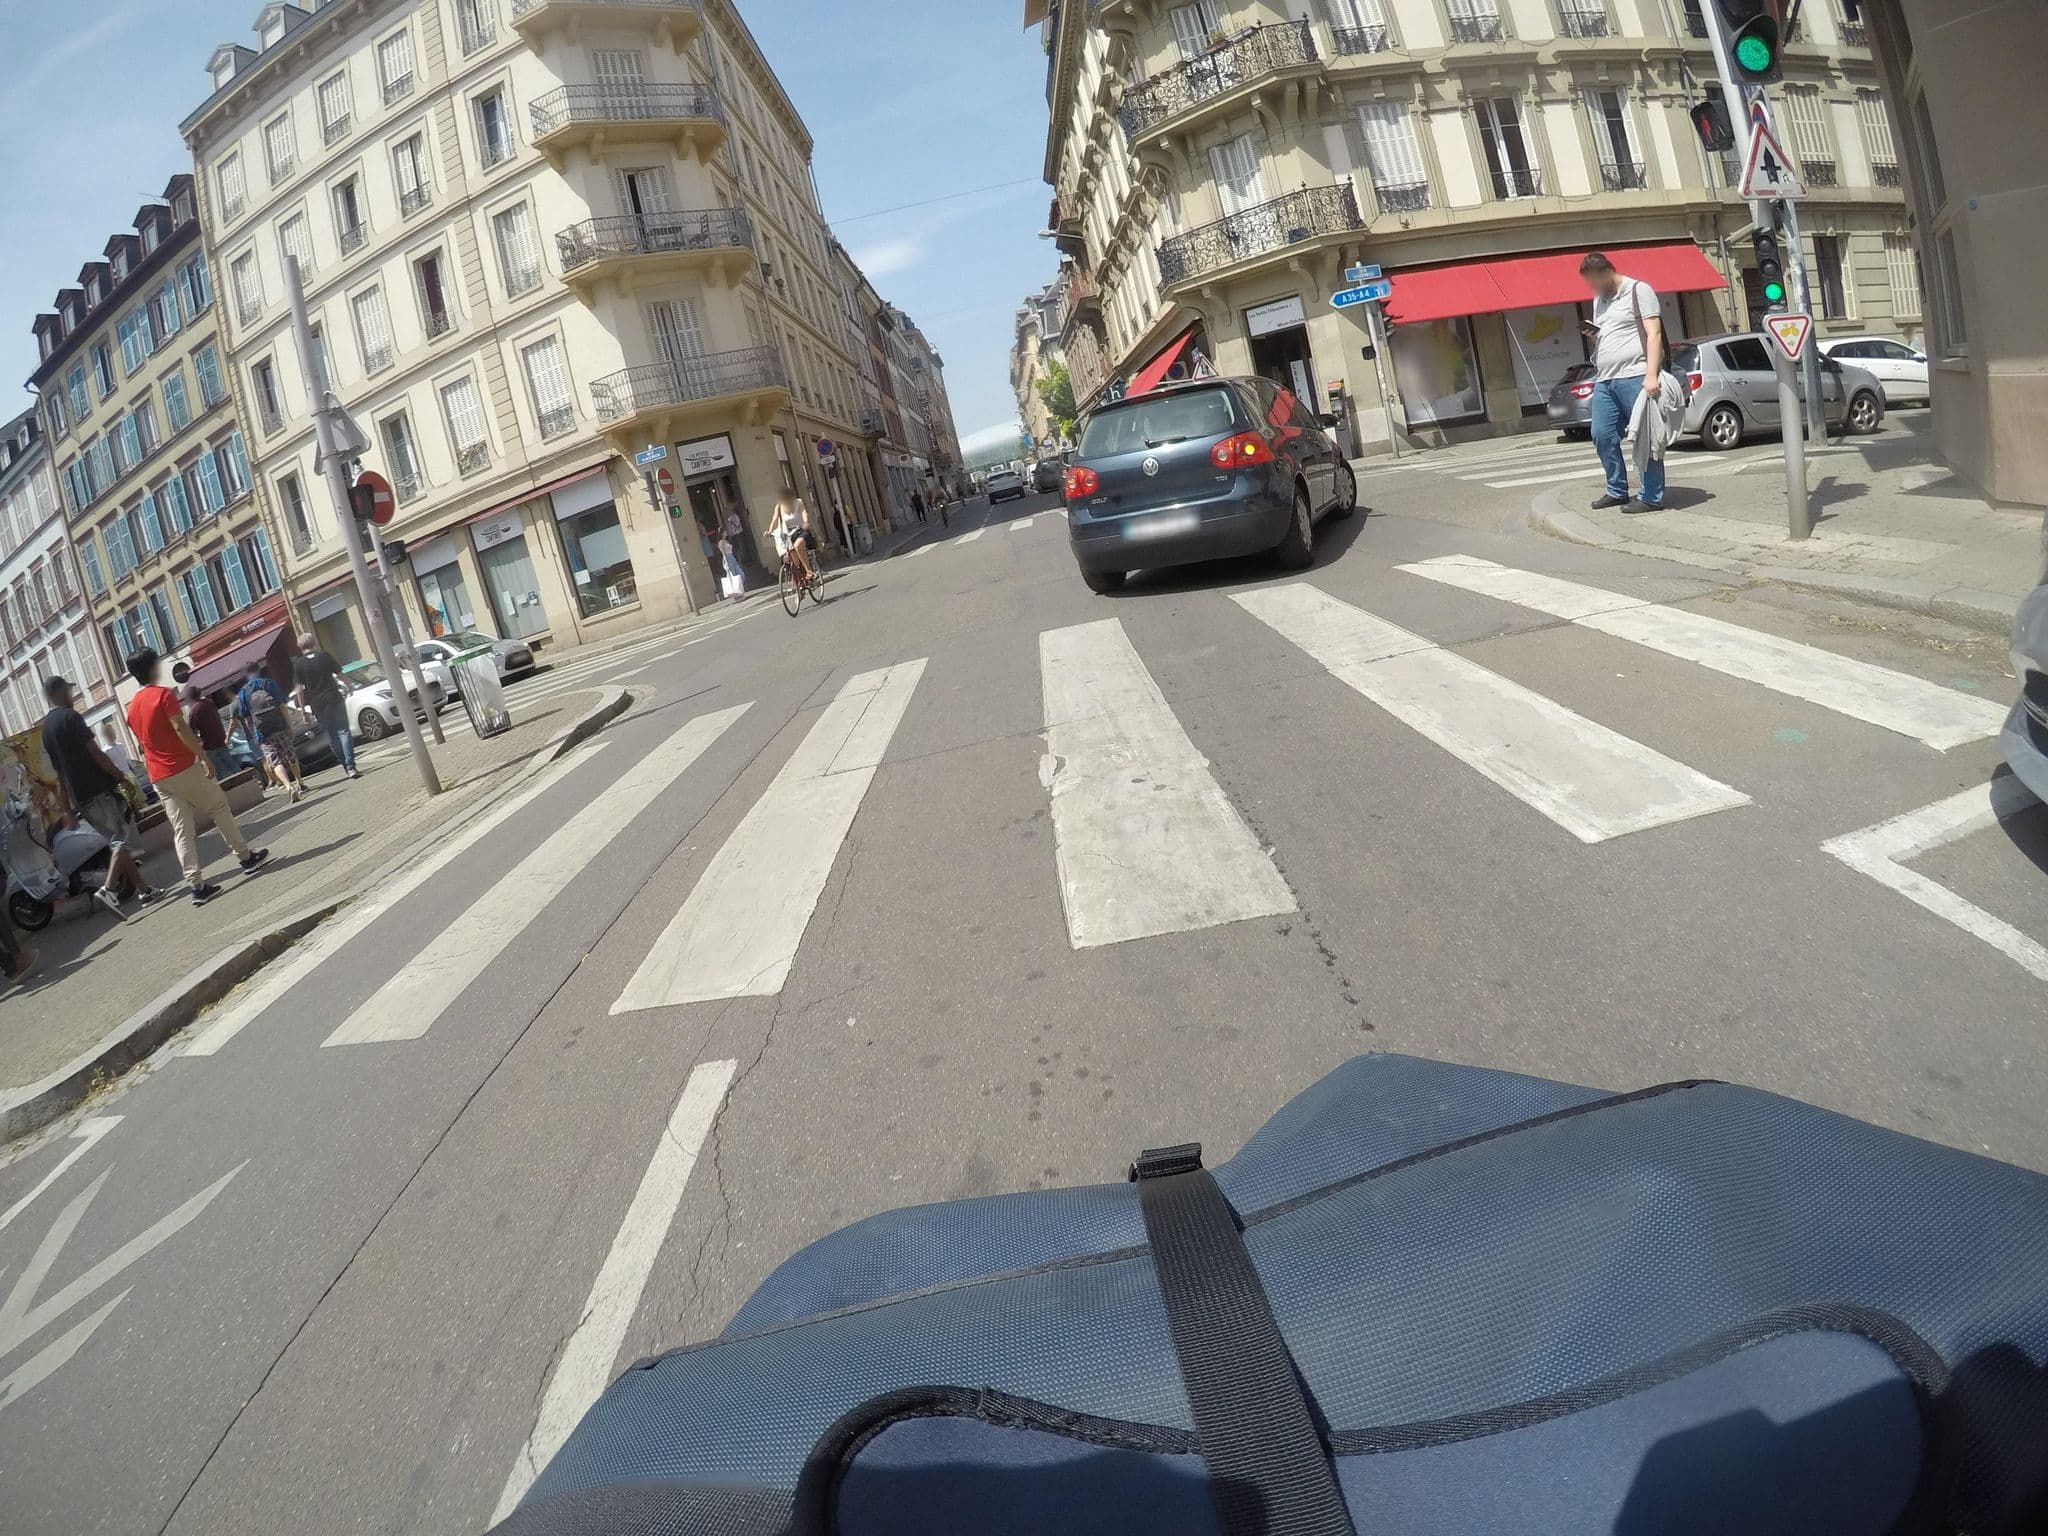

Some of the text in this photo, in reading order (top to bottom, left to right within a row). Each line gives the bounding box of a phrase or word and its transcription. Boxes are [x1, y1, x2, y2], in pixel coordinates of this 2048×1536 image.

[1342, 289, 1370, 303] A35-A4
[922, 406, 938, 449] HOTEL
[1091, 497, 1108, 505] GOLF
